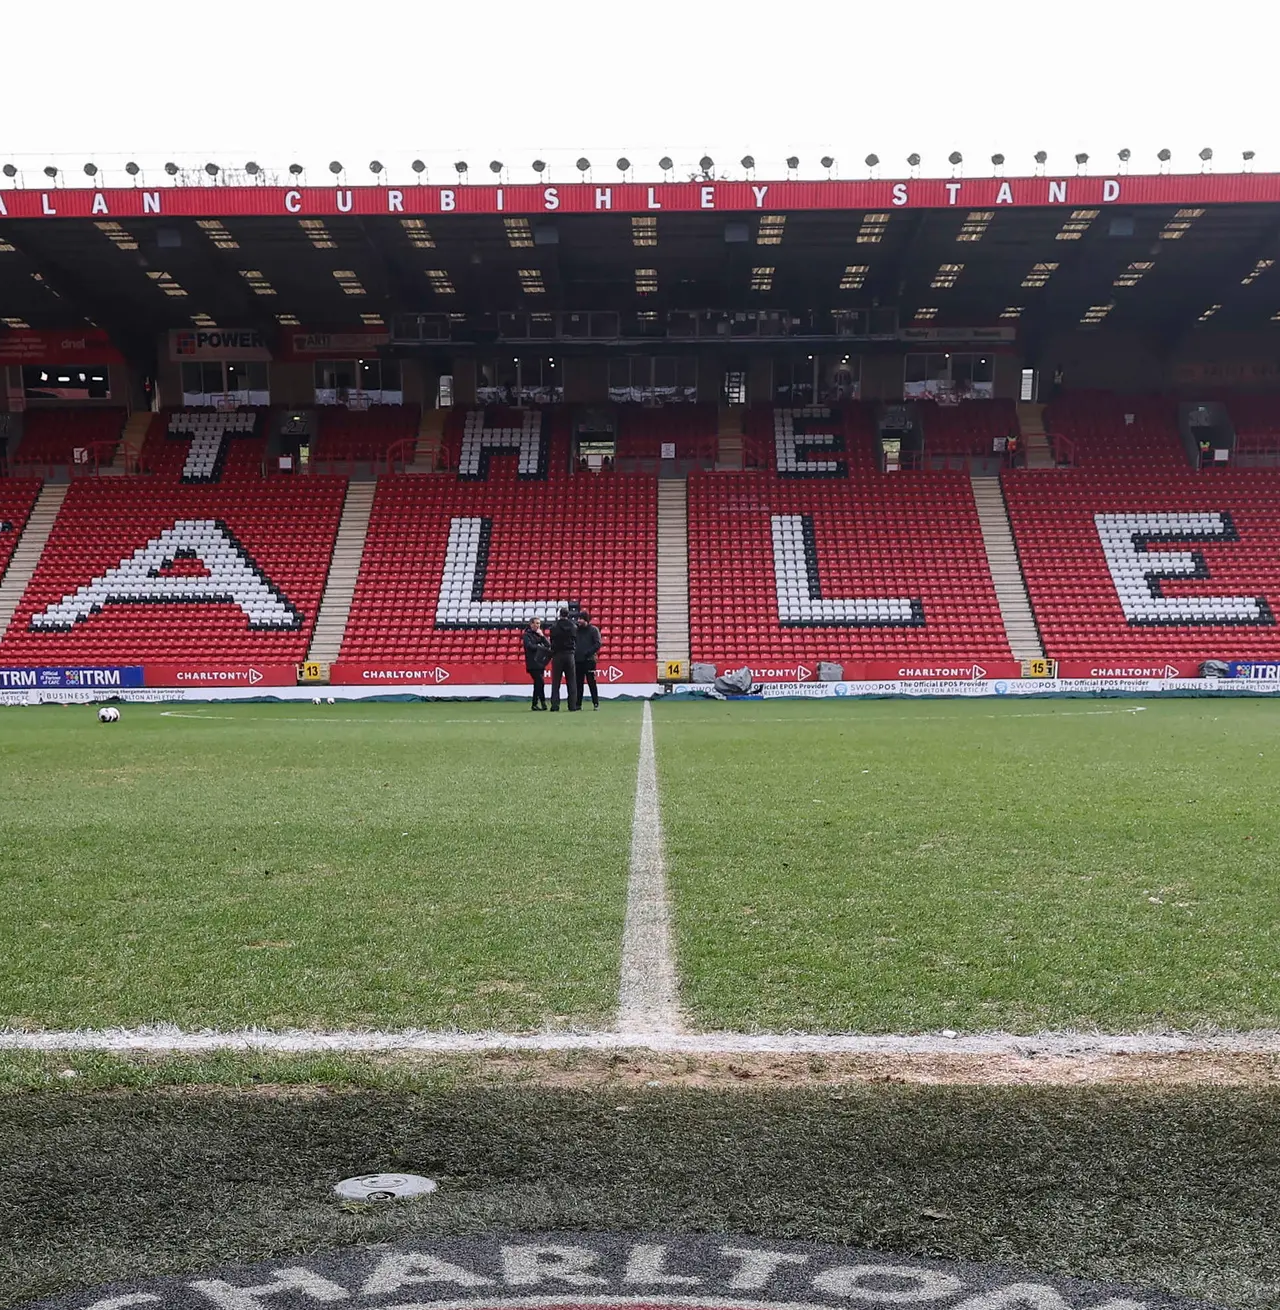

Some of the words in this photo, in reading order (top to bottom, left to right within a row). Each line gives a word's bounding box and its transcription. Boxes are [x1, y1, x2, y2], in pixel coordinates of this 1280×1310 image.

[285, 187, 768, 212] CURBISHLEY
[892, 180, 1120, 206] STAND
[306, 666, 318, 676] 13
[668, 665, 679, 675] 14
[1032, 663, 1044, 673] 15
[79, 670, 120, 685] ITRM
